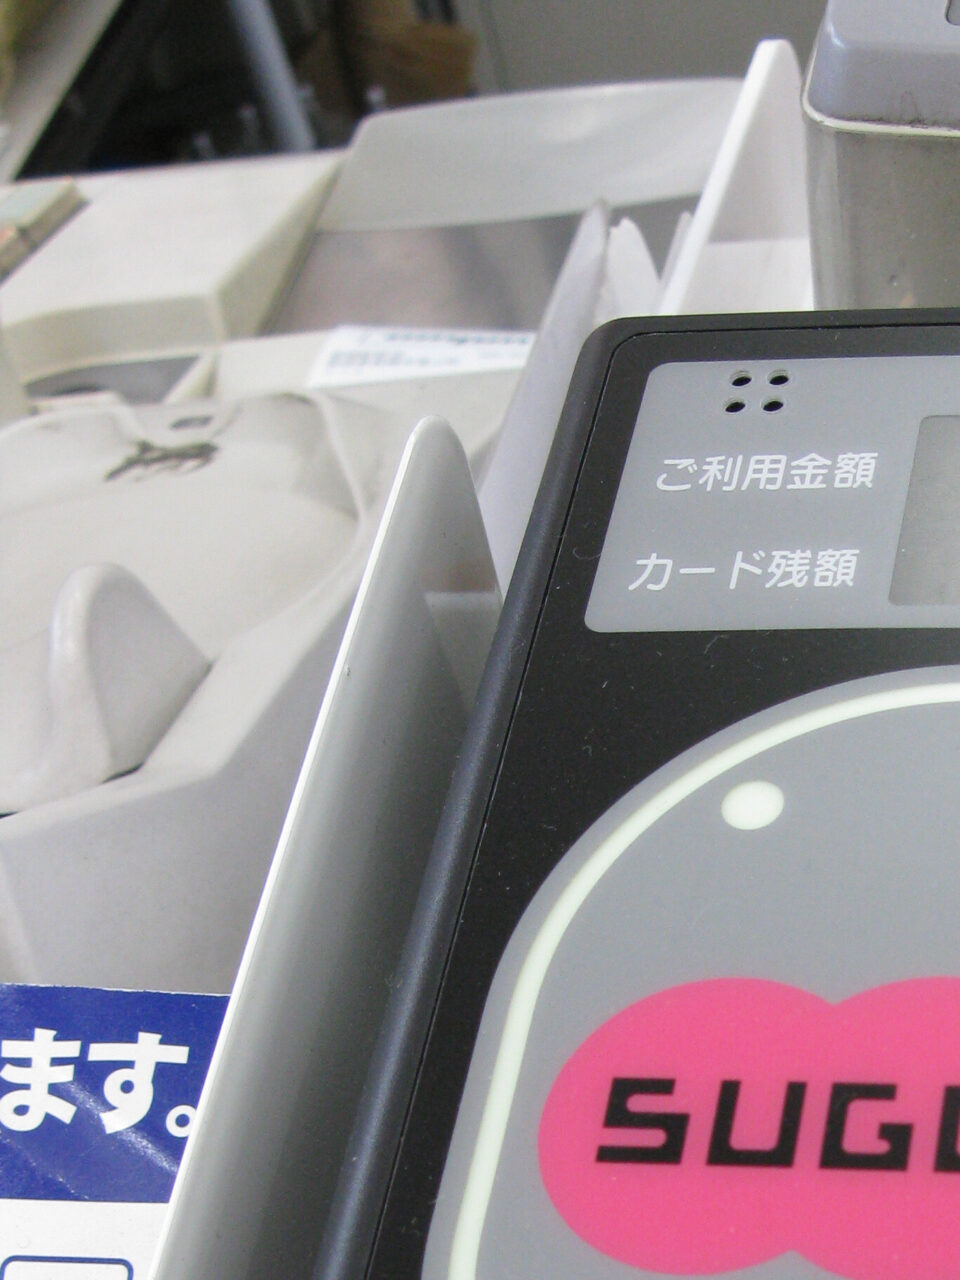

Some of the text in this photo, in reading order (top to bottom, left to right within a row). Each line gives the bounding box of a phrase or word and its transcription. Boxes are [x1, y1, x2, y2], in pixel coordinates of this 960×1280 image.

[656, 452, 878, 491] ご利用金額
[628, 549, 860, 590] カード残額
[0, 1027, 197, 1138] ます。
